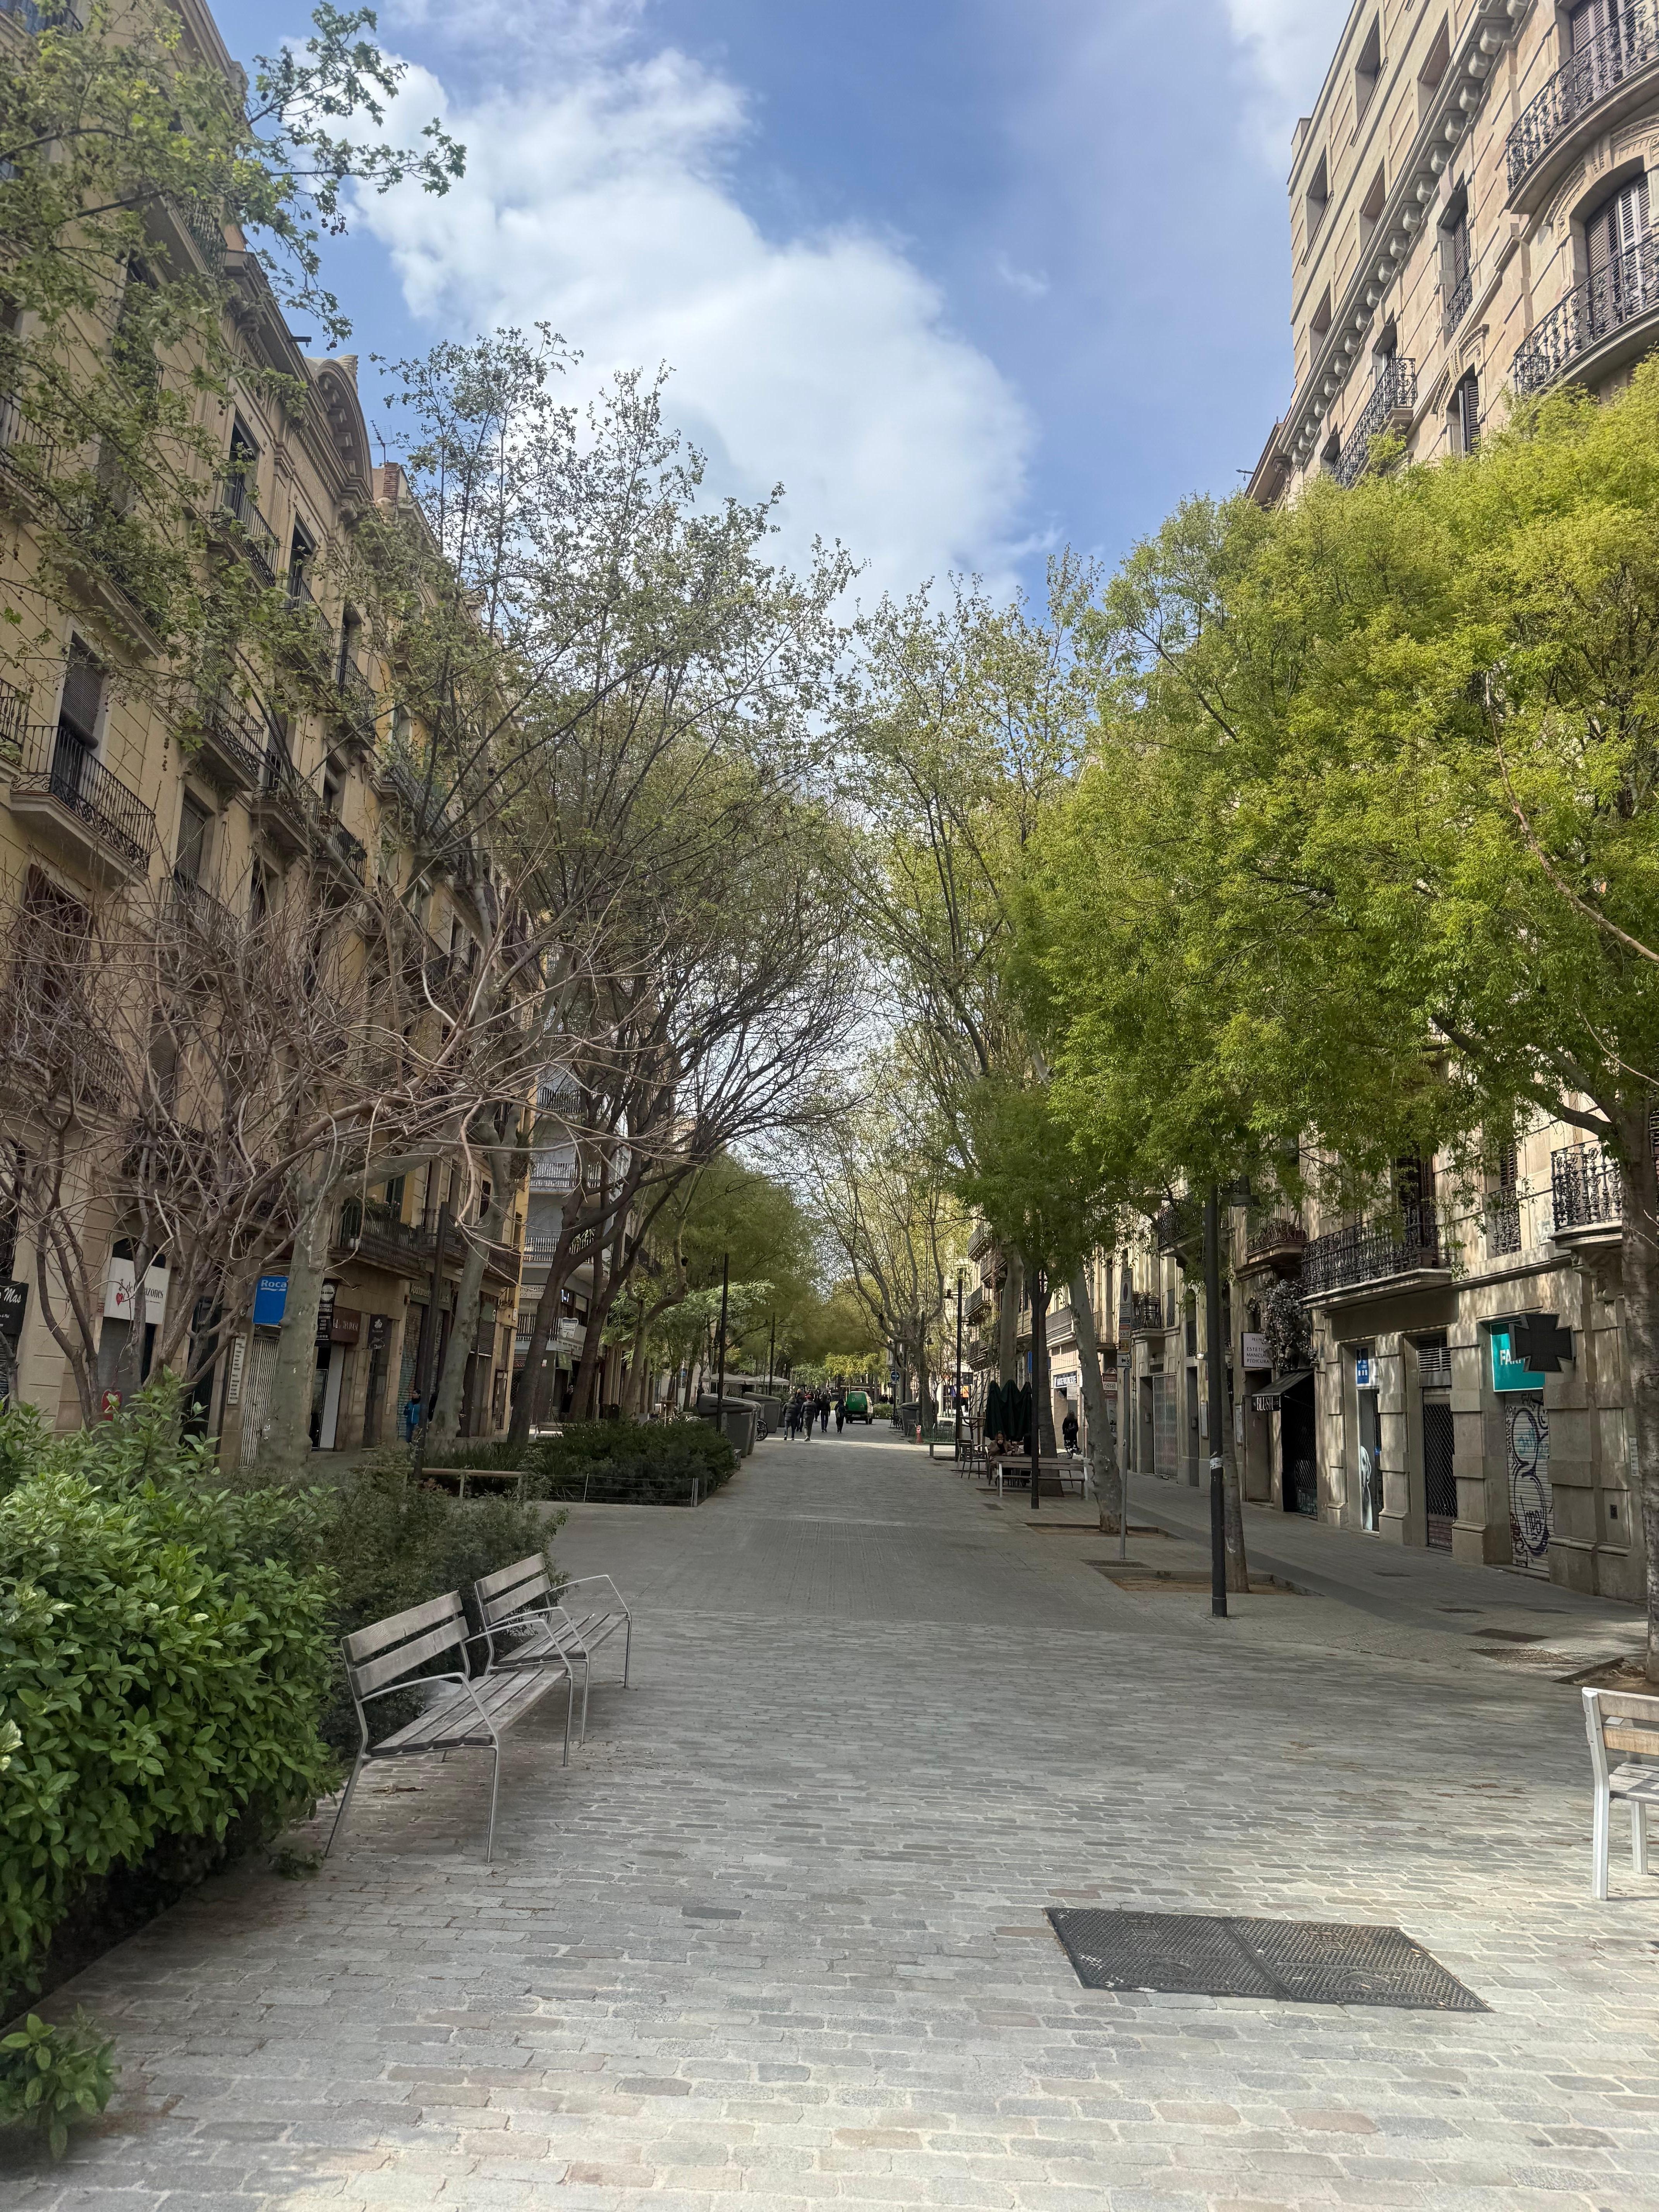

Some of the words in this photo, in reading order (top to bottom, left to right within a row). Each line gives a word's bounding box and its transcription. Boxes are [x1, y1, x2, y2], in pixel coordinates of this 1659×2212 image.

[261, 1279, 287, 1288] Roca
[4, 1287, 21, 1303] Mas
[1257, 1396, 1273, 1411] BLUSH
